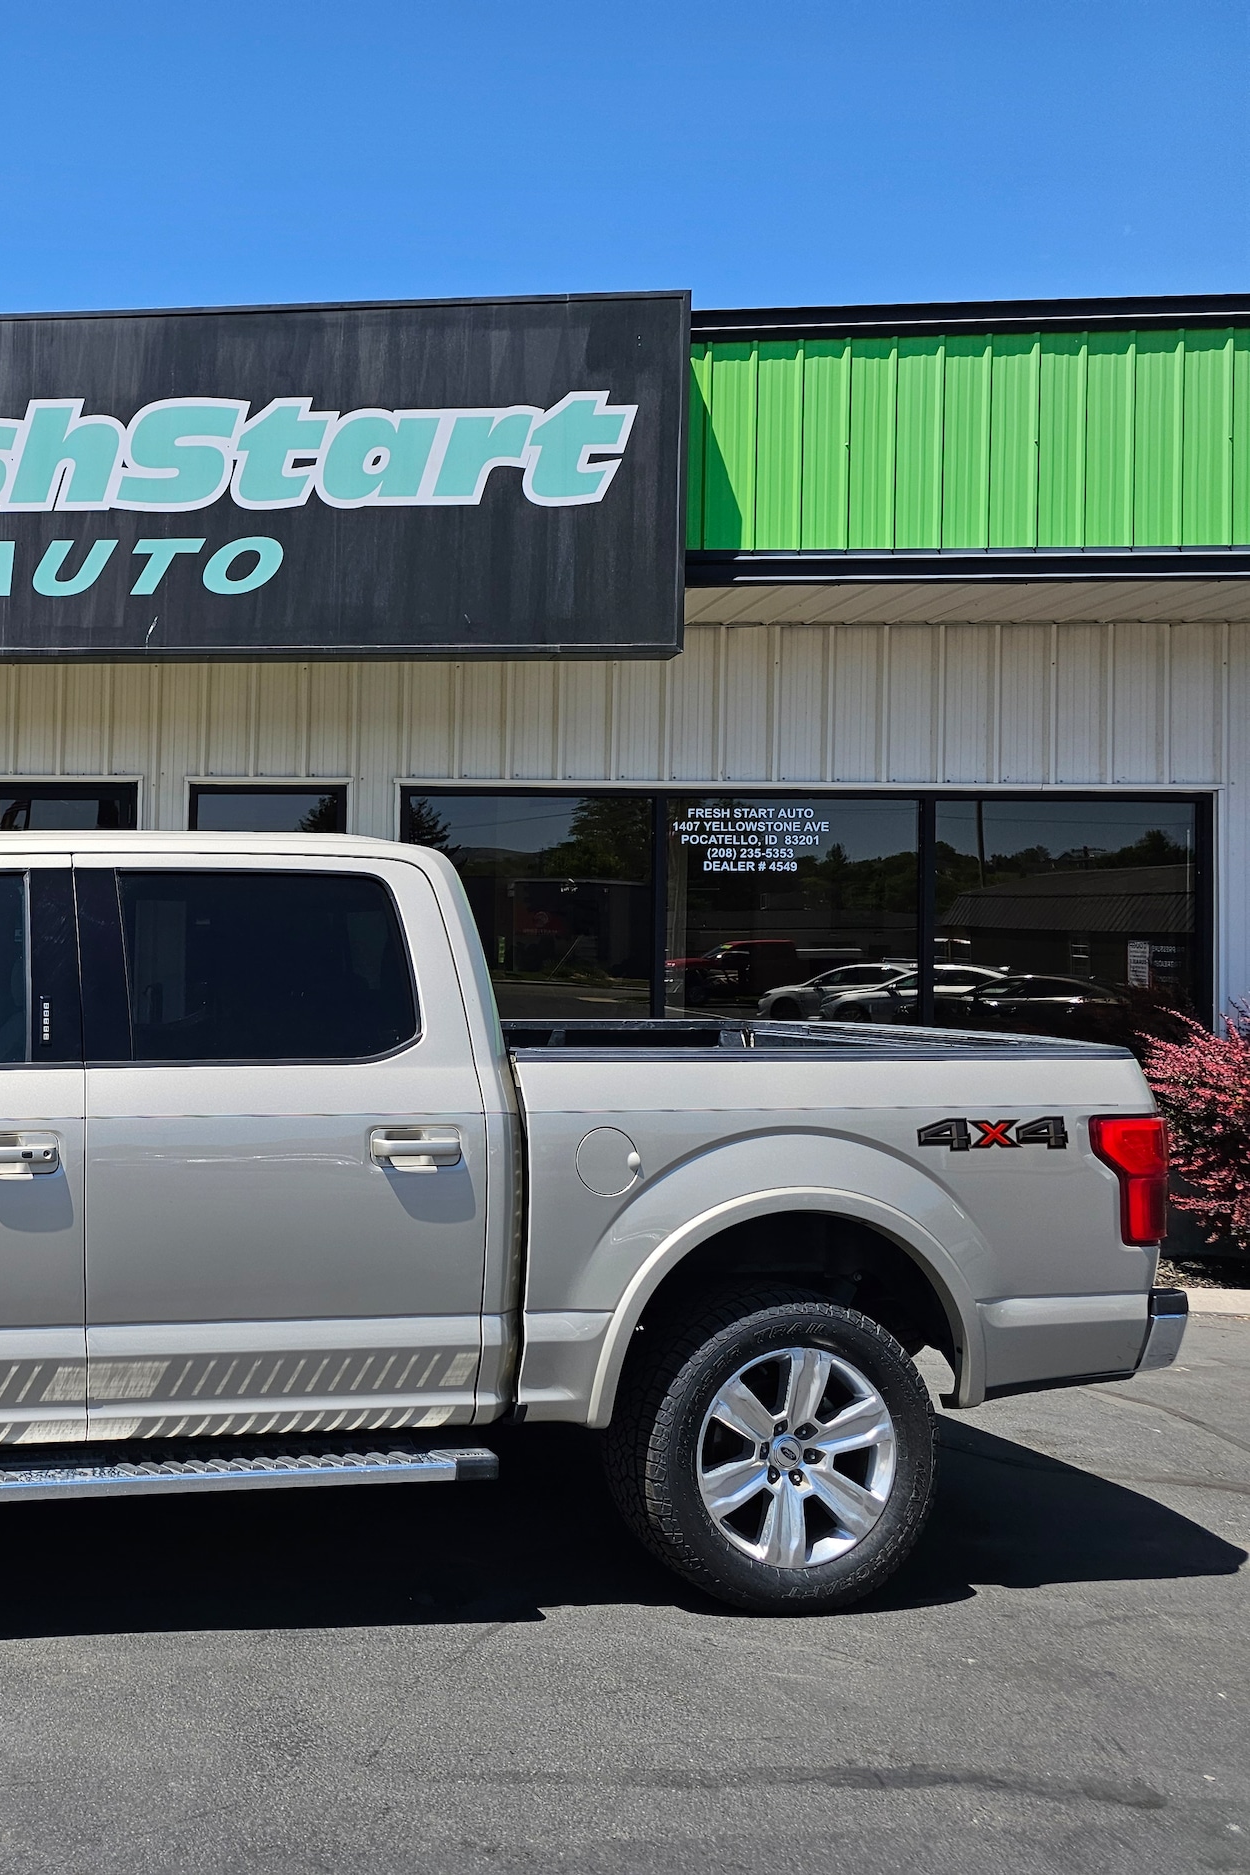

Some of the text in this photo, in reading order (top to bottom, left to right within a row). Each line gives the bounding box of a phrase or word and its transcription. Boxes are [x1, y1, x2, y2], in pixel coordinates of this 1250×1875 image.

[687, 808, 814, 819] FRESH START AUTO
[672, 821, 830, 832] 1407 YELLOWSTONE AVE
[681, 834, 820, 847] POCATELLO, ID 83201
[707, 848, 794, 860] (208) 235-5353
[703, 861, 798, 872] DEALER # 4549
